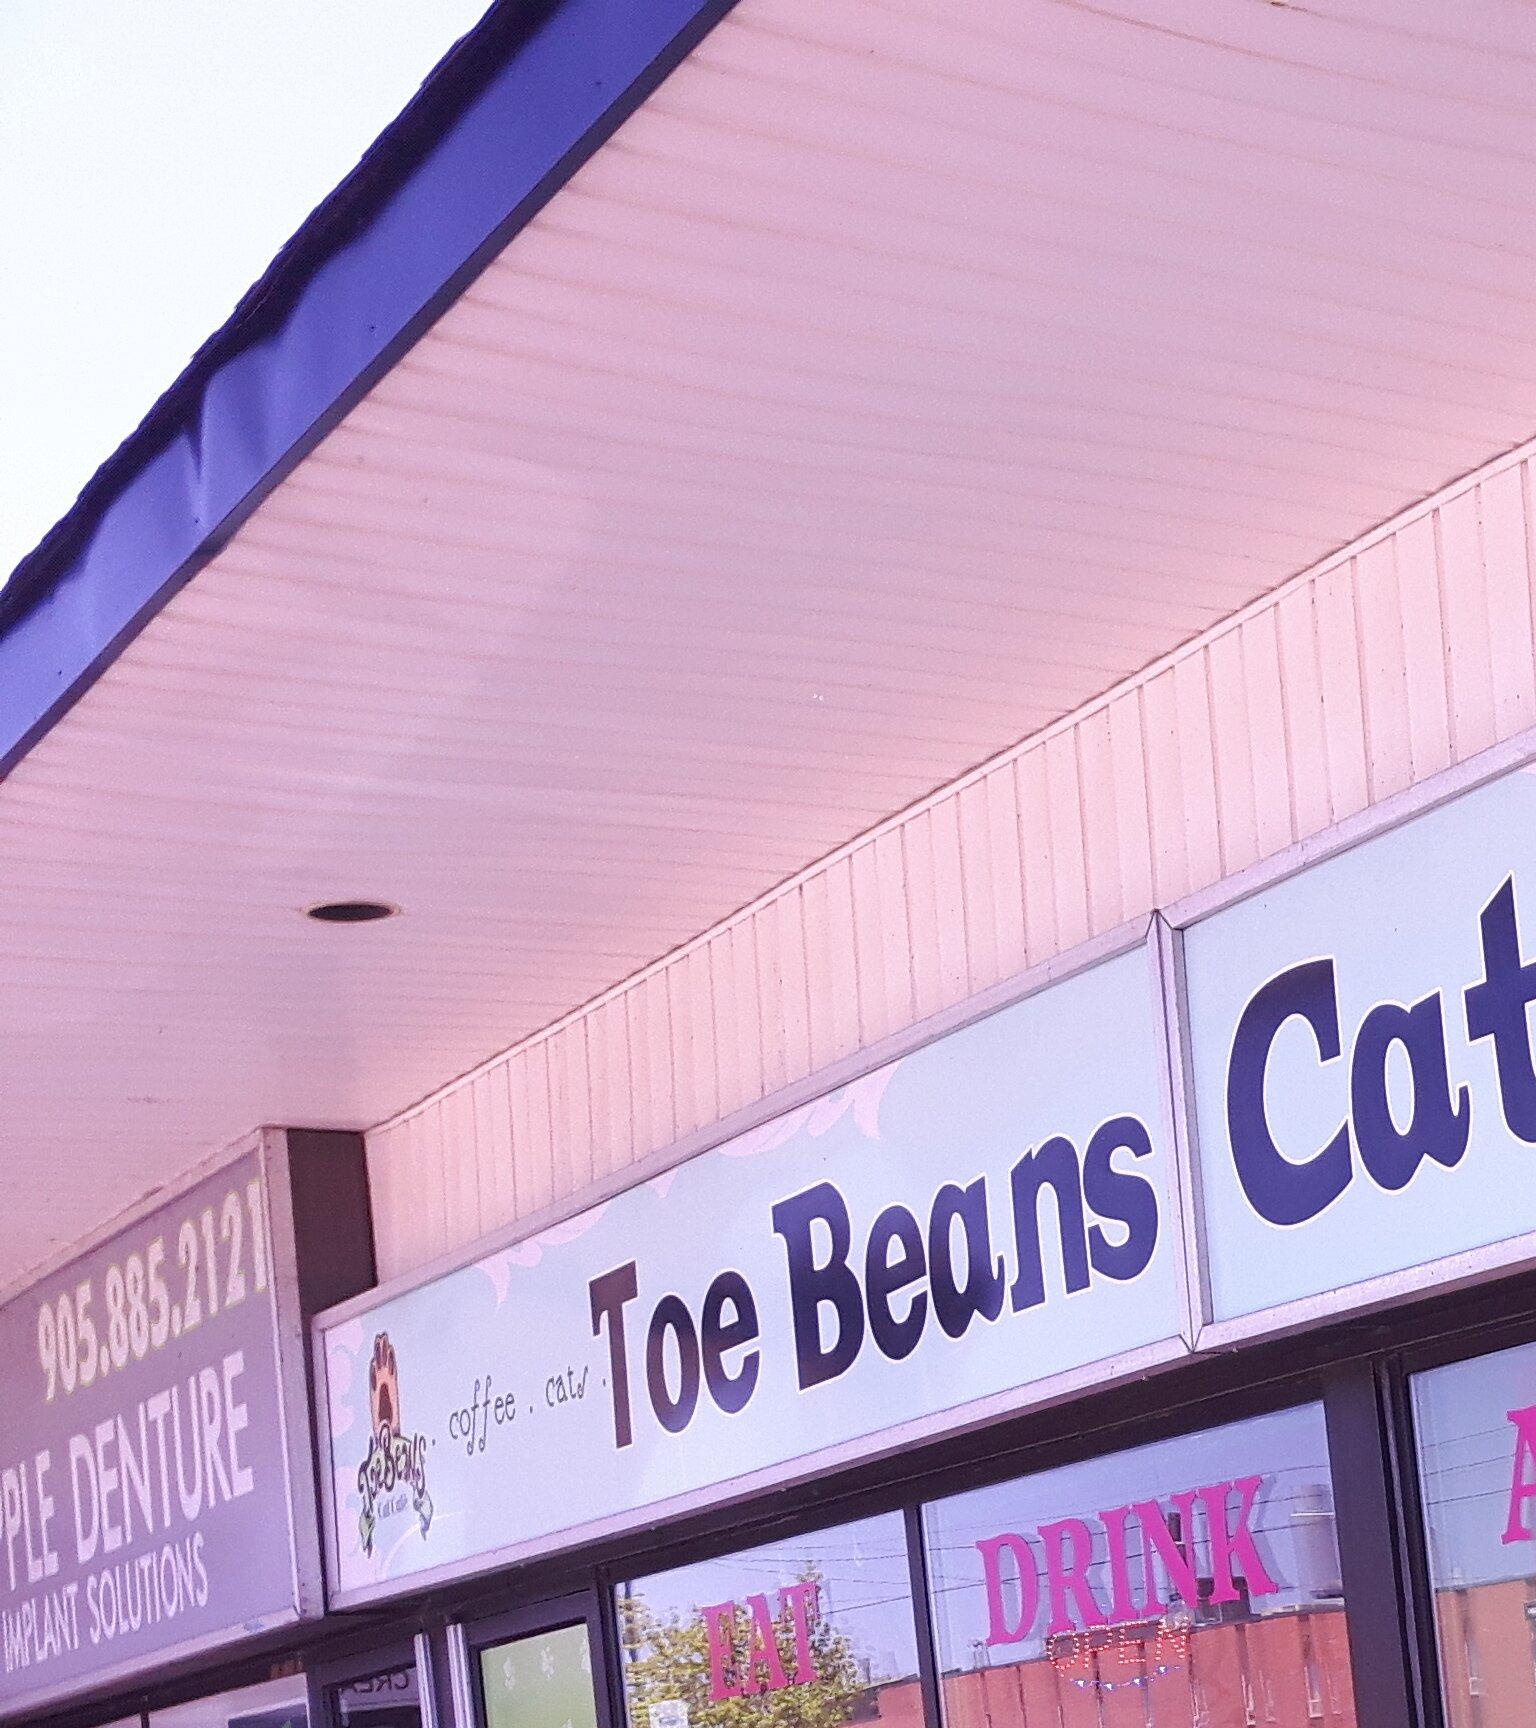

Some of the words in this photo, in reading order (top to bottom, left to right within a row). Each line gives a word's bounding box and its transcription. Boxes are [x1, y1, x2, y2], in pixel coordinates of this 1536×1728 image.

[37, 1178, 268, 1404] 905.885.2121
[587, 1260, 761, 1450] Toe
[771, 1112, 1160, 1393] Beans
[0, 1449, 59, 1592] PLE
[68, 1351, 254, 1565] DENTURE
[447, 1376, 516, 1456] coffee
[545, 1364, 590, 1408] cats
[2, 1582, 79, 1674] IMPLANT
[86, 1531, 208, 1646] SOLUTIONS
[702, 1580, 822, 1702] EAT
[975, 1474, 1279, 1647] DRINK
